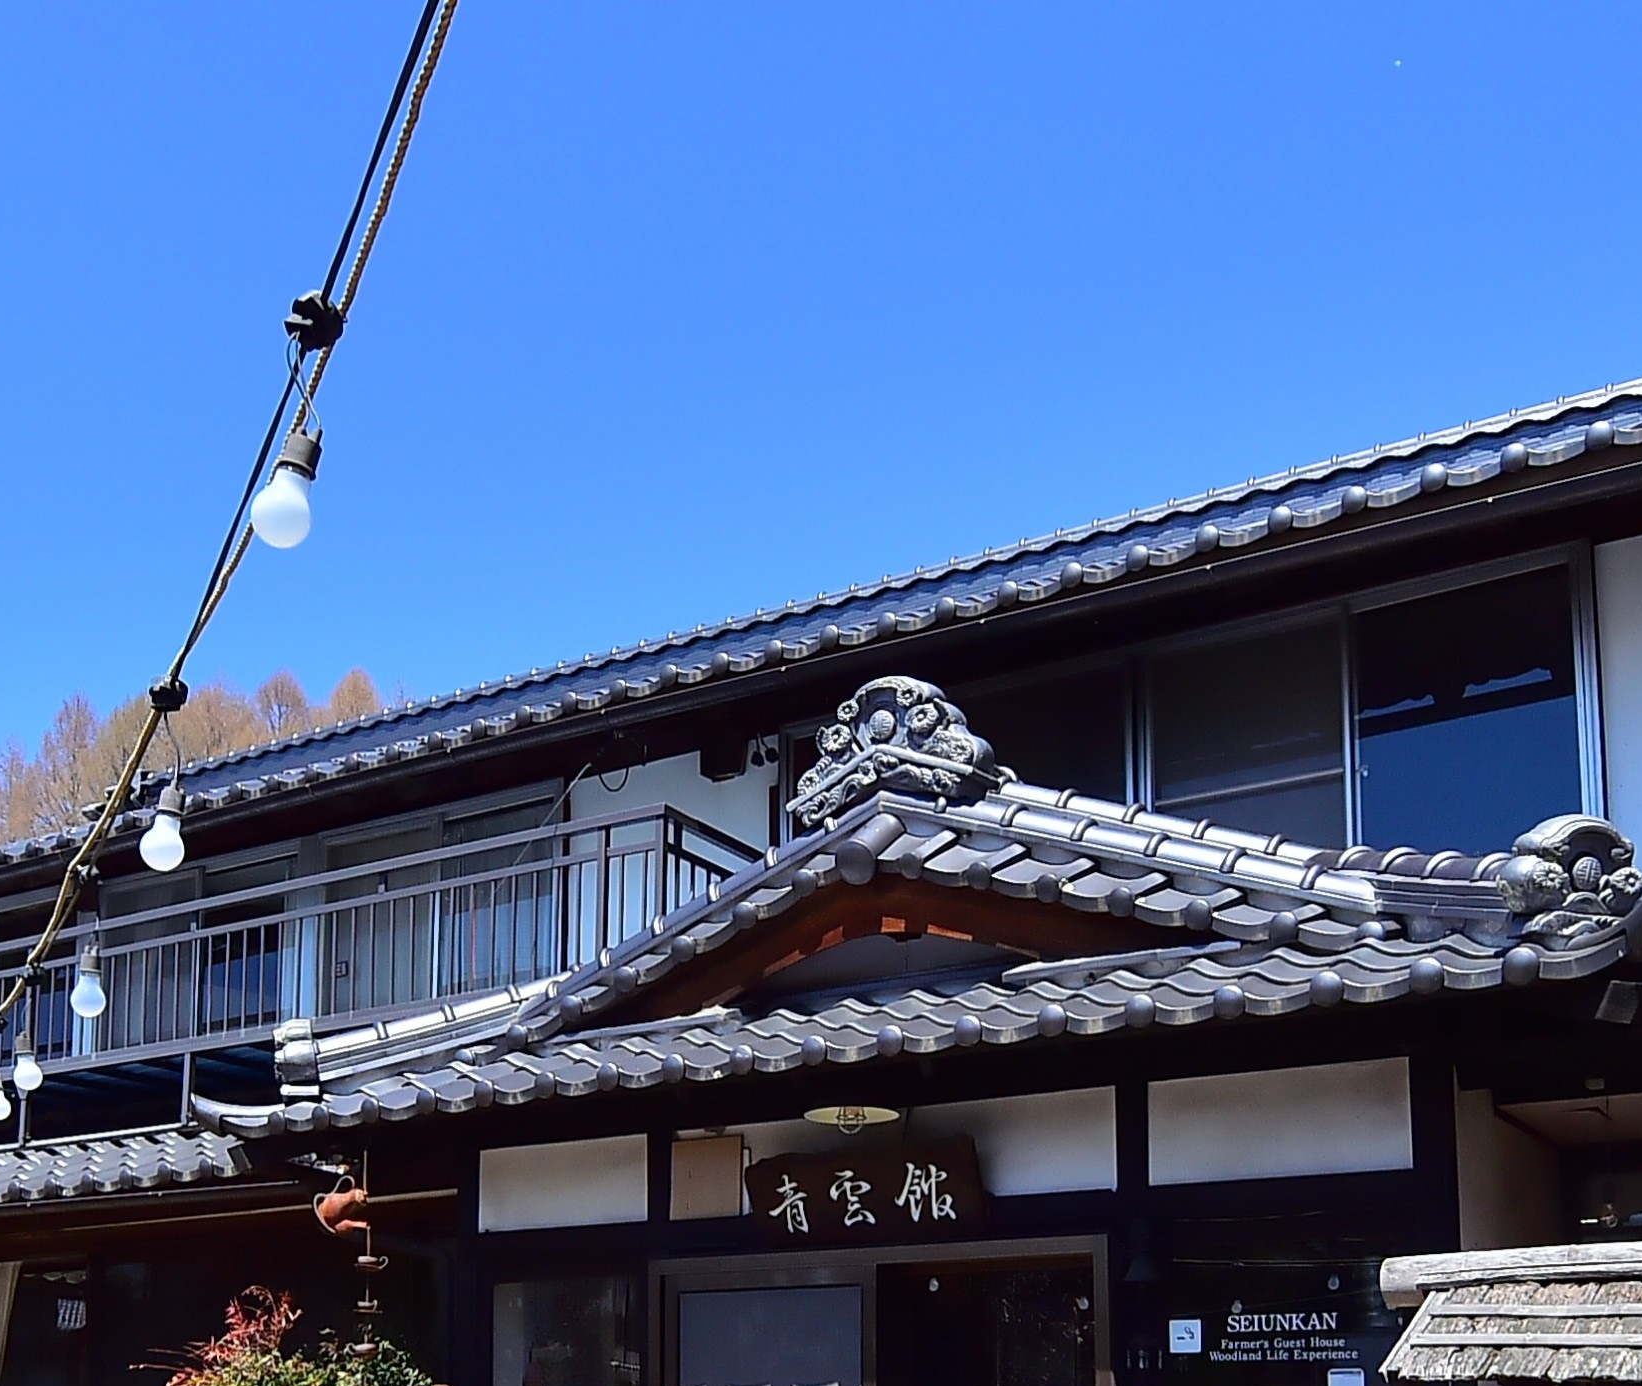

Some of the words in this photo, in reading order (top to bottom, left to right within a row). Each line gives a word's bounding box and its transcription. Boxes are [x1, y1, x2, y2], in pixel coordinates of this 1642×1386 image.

[1226, 1312, 1338, 1333] SEIUNKAN
[1220, 1338, 1270, 1350] Farmer's
[1273, 1337, 1306, 1349] Guest
[1310, 1336, 1346, 1348] House
[1209, 1350, 1262, 1362] Woodland
[1266, 1349, 1290, 1361] Life
[1293, 1349, 1359, 1362] Experience
